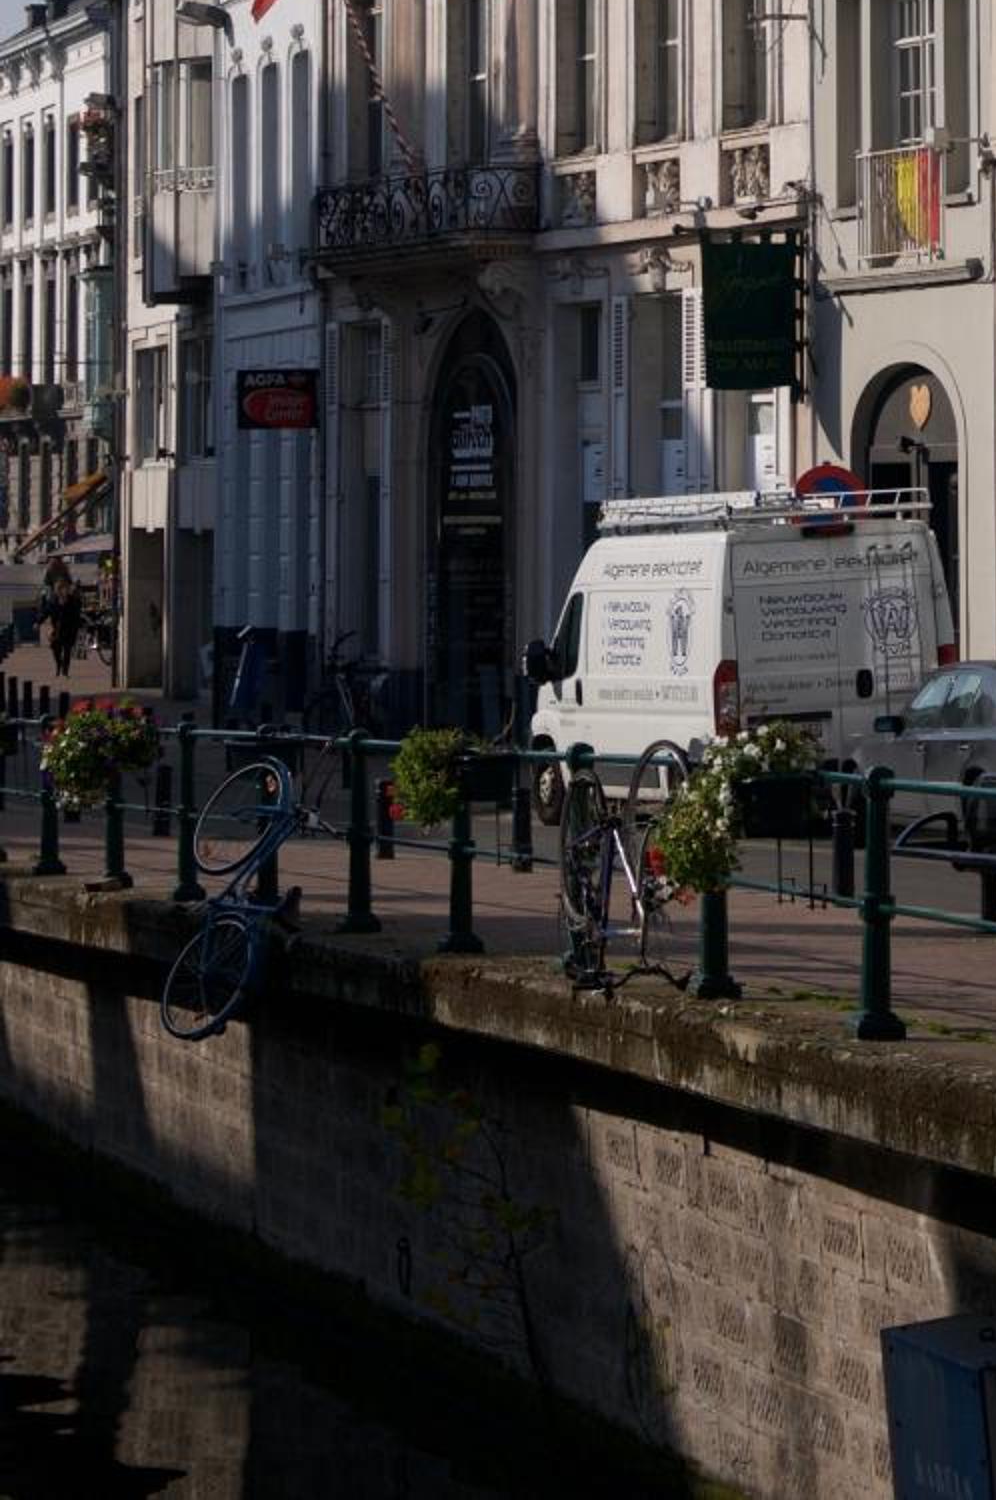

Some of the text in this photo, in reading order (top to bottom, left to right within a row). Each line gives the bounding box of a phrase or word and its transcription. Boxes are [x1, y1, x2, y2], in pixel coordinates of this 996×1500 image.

[243, 373, 286, 388] AGFA
[603, 563, 650, 580] Algemene
[743, 557, 827, 575] Algemene
[759, 593, 844, 605] Nieuwbouw
[760, 603, 847, 616] Verbouwing
